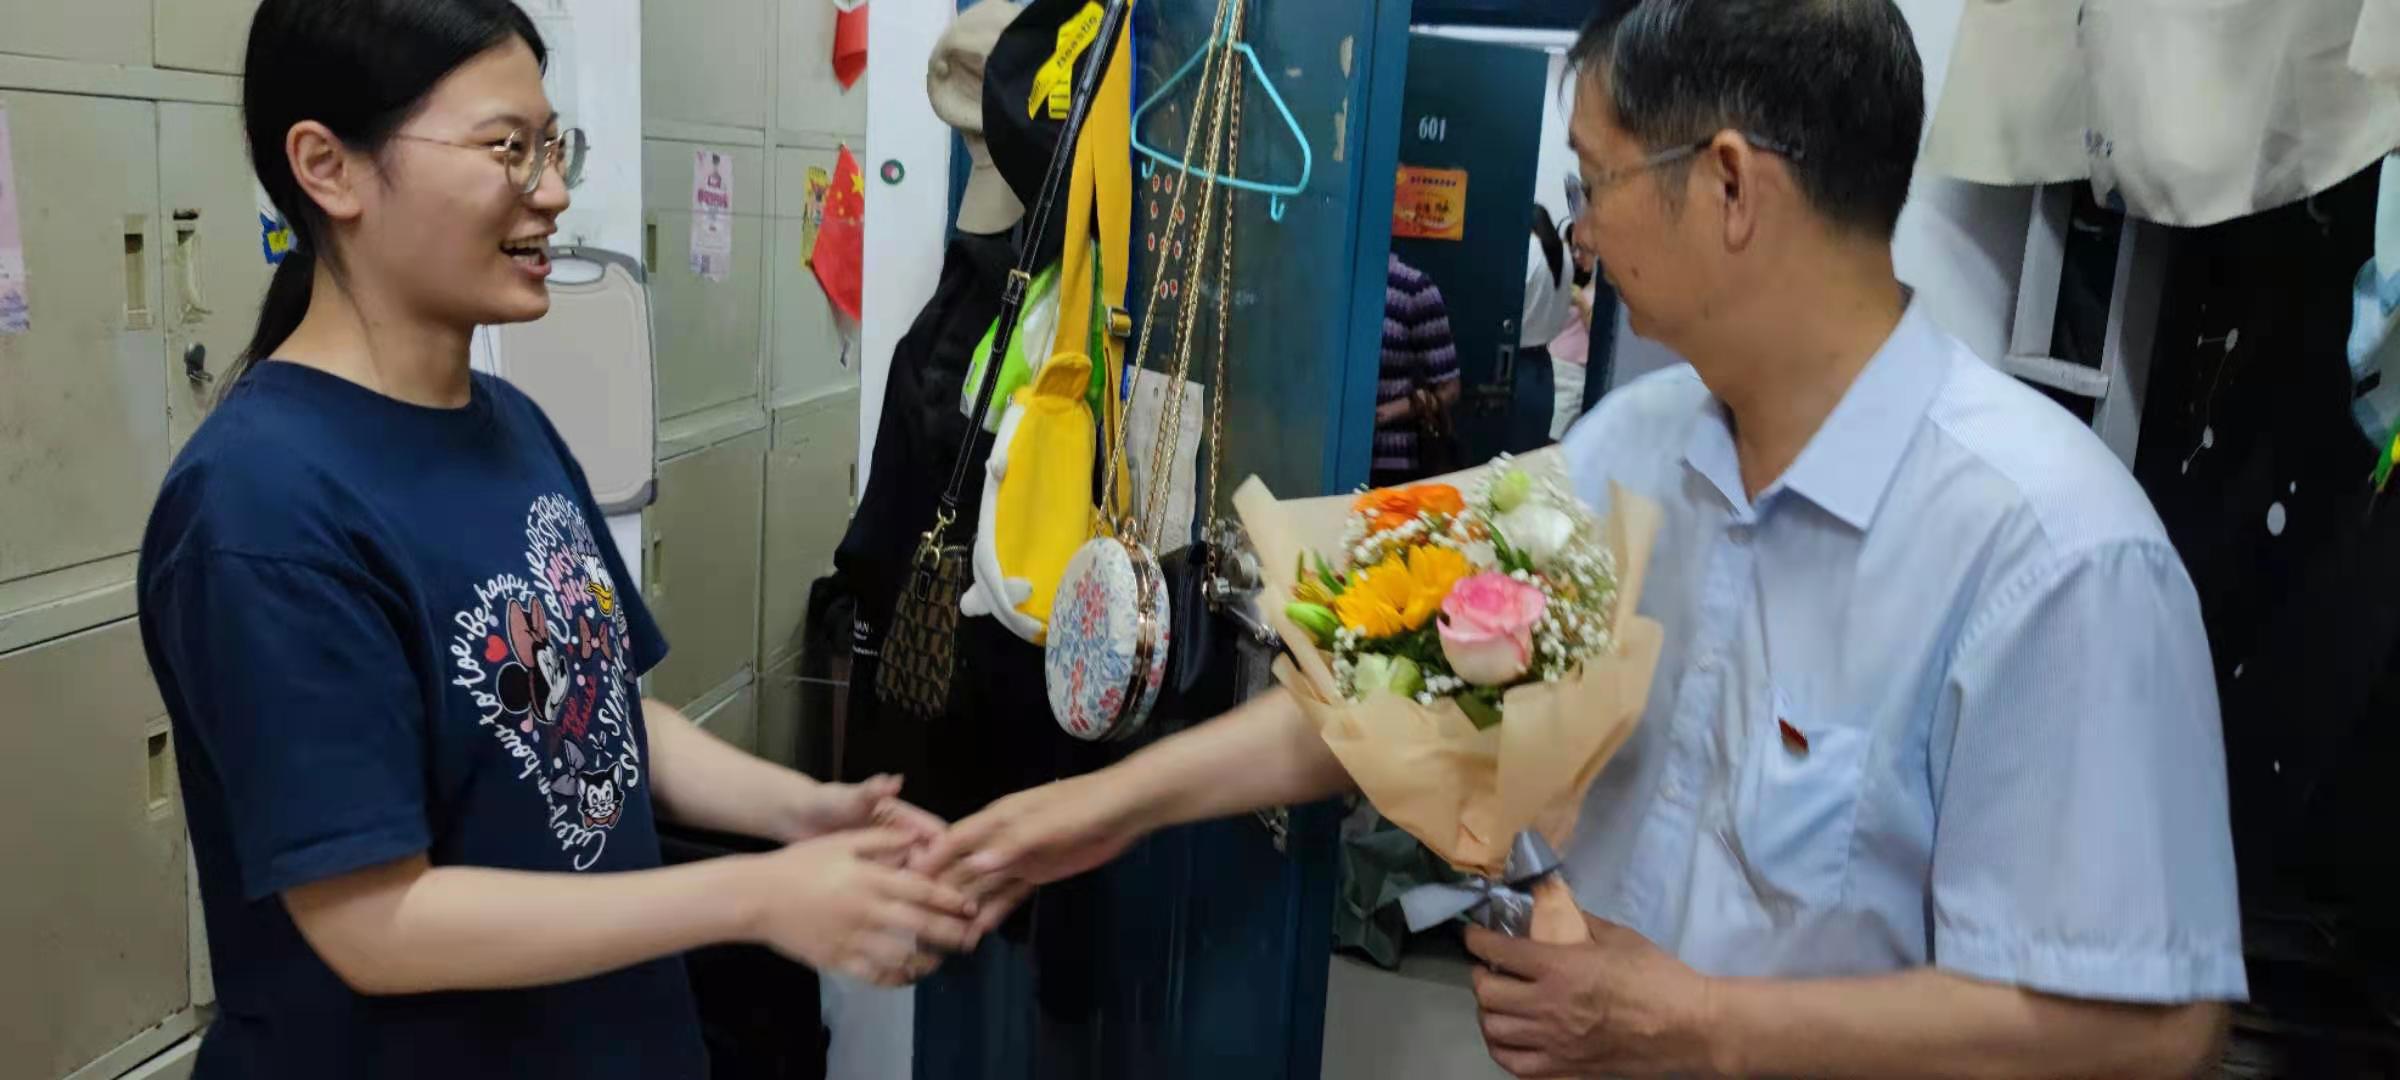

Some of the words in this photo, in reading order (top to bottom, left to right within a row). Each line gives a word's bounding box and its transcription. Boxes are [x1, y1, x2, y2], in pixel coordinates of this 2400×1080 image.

[1418, 114, 1447, 142] 601
[473, 573, 537, 608] happy
[454, 606, 492, 638] Be
[450, 635, 487, 689] toe
[470, 689, 503, 726] to
[553, 820, 607, 871] Cute
